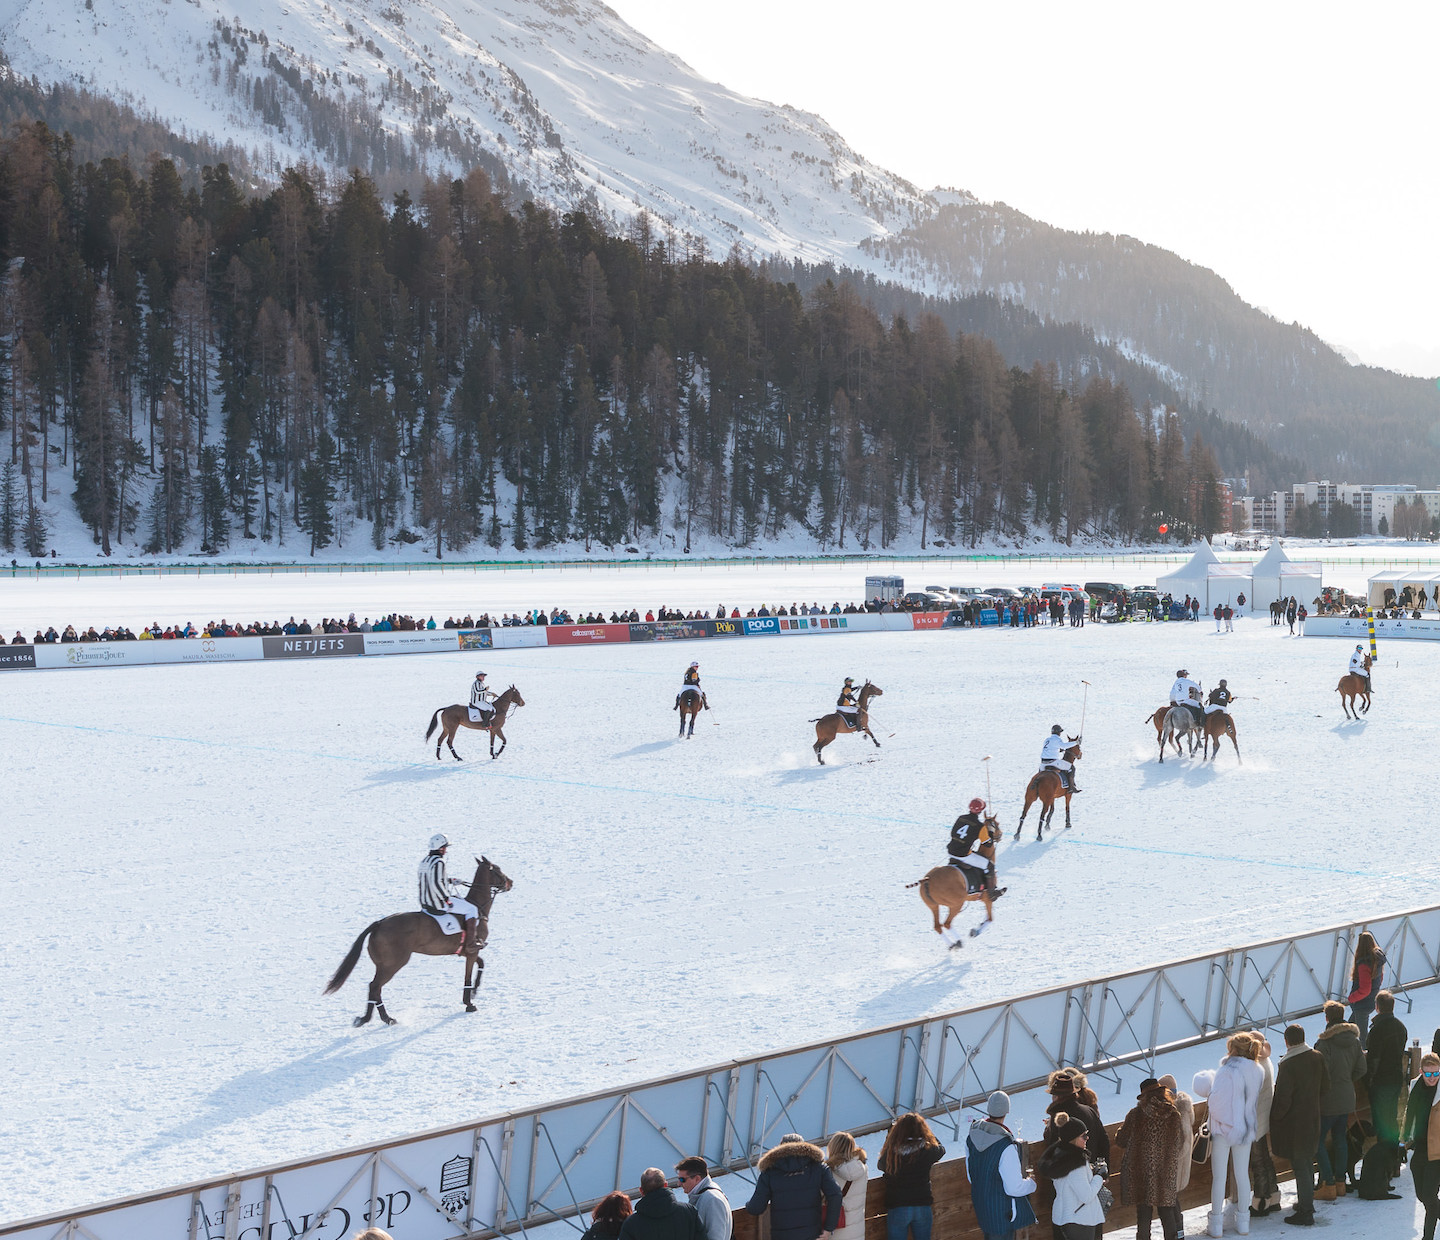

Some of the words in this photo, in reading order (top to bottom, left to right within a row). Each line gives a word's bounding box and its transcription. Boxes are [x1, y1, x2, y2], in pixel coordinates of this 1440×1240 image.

[715, 622, 735, 632] Polo
[748, 620, 774, 628] POLO
[284, 639, 345, 654] NETJETS
[1177, 683, 1182, 691] 3
[1219, 691, 1226, 699] 2
[1044, 740, 1050, 749] 2
[956, 824, 970, 839] 4
[364, 1190, 412, 1228] de
[187, 1200, 266, 1233] GEEVE
